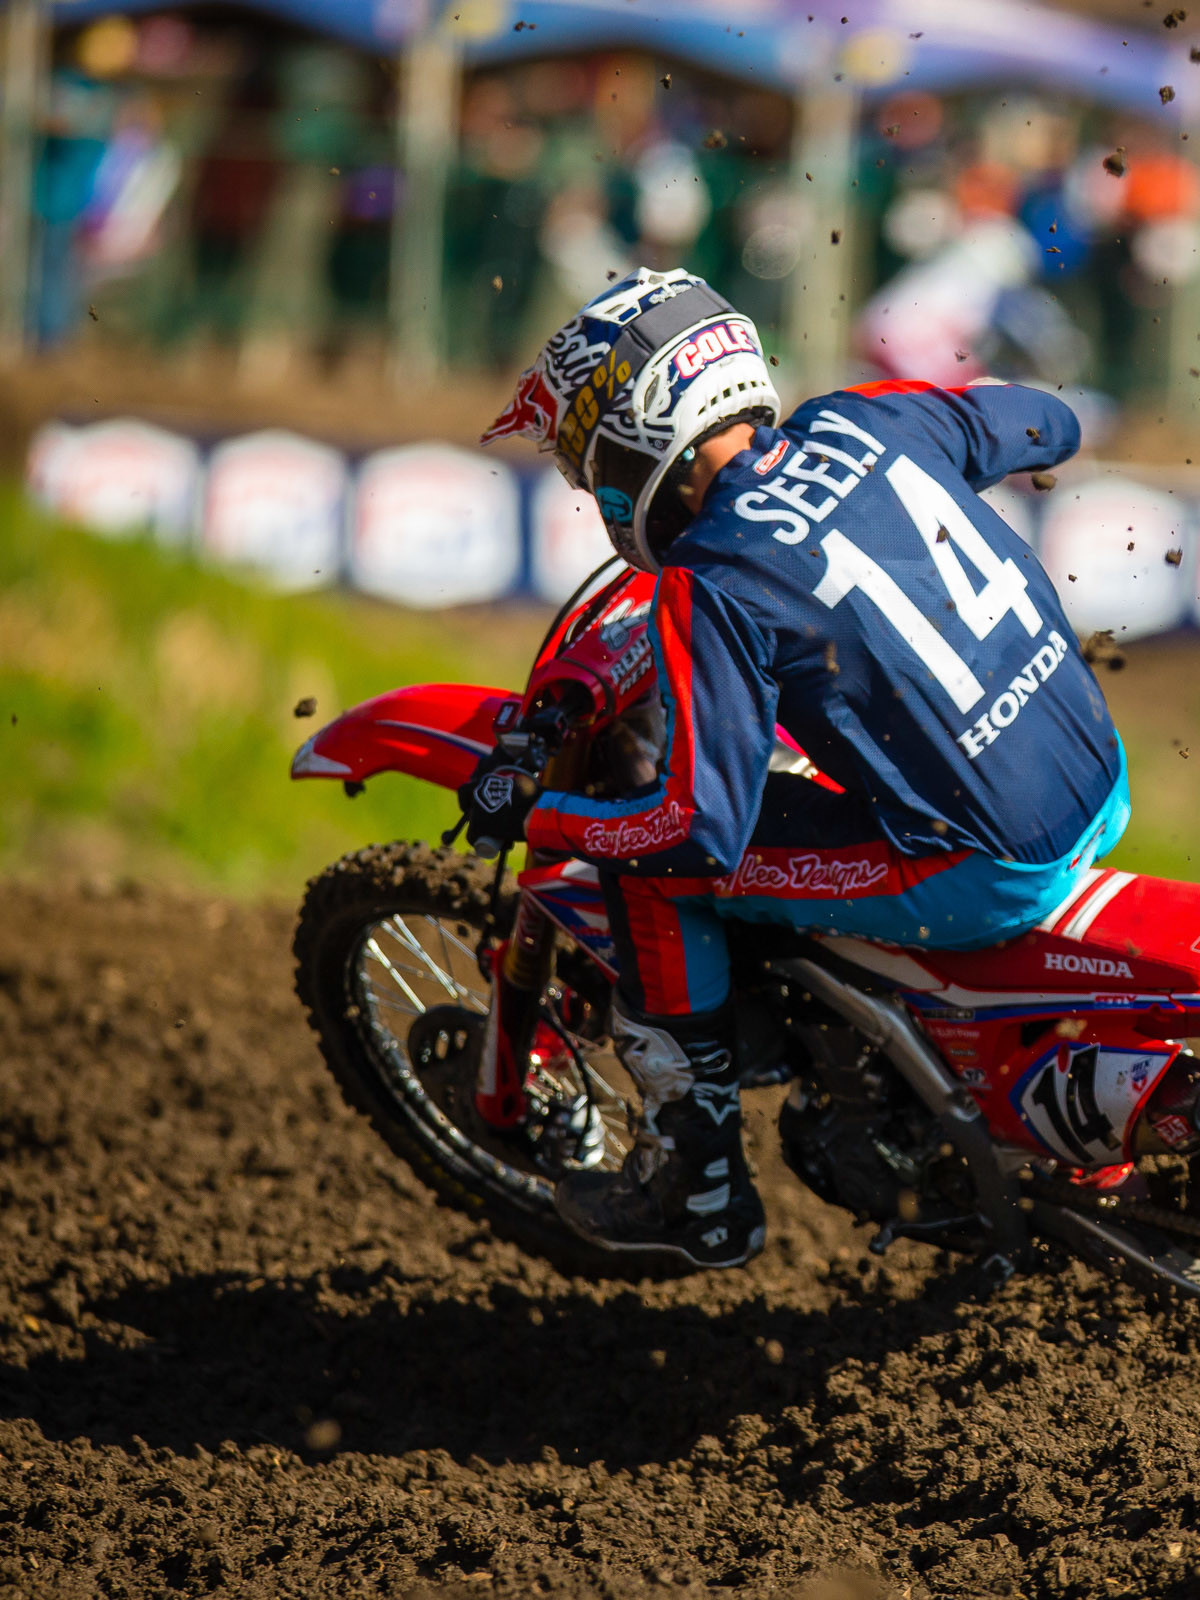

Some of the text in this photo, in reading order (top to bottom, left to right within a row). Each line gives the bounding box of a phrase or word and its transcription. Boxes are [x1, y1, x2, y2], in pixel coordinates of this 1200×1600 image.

[673, 322, 756, 380] COLE
[734, 410, 887, 545] SEELY
[812, 454, 1044, 716] 14
[957, 630, 1070, 760] HONDA
[741, 853, 789, 889] Lee
[789, 853, 889, 895] Designs
[1044, 952, 1134, 979] HONDA
[1031, 1044, 1123, 1163] 14
